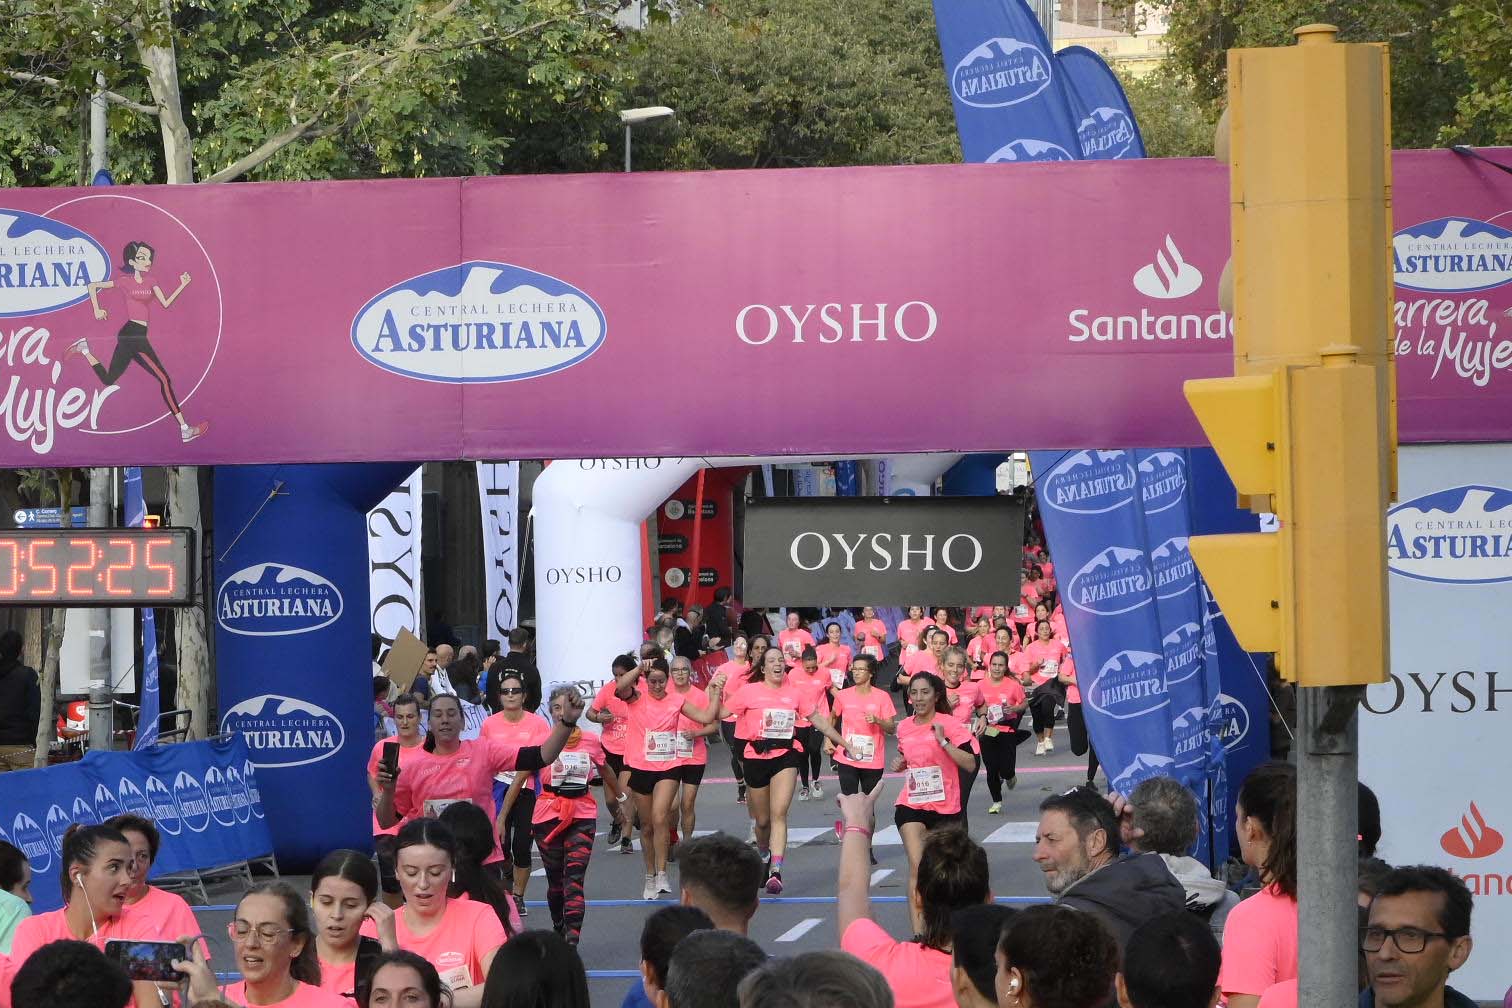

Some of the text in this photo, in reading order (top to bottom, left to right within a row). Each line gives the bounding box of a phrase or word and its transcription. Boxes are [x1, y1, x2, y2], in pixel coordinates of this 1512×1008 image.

[13, 244, 86, 257] LECHERA
[1408, 242, 1459, 252] CENTRAL
[410, 302, 579, 317] CENTRAL LECHERA
[735, 301, 938, 345] OYSHO
[1394, 299, 1489, 327] arrera
[371, 308, 587, 355] ASTURIANA
[1068, 308, 1233, 343] Santand
[1418, 329, 1436, 355] la
[1431, 322, 1512, 387] Muje
[1414, 519, 1483, 531] CENTRAL
[790, 532, 983, 573] OYSHO
[546, 564, 622, 585] OYSHO
[233, 587, 329, 597] CENTRAL LECHERA
[221, 592, 334, 620] ASTURIANA
[1360, 670, 1512, 715] OYSH
[227, 723, 335, 750] TURIANA
[281, 719, 330, 728] LECHERA
